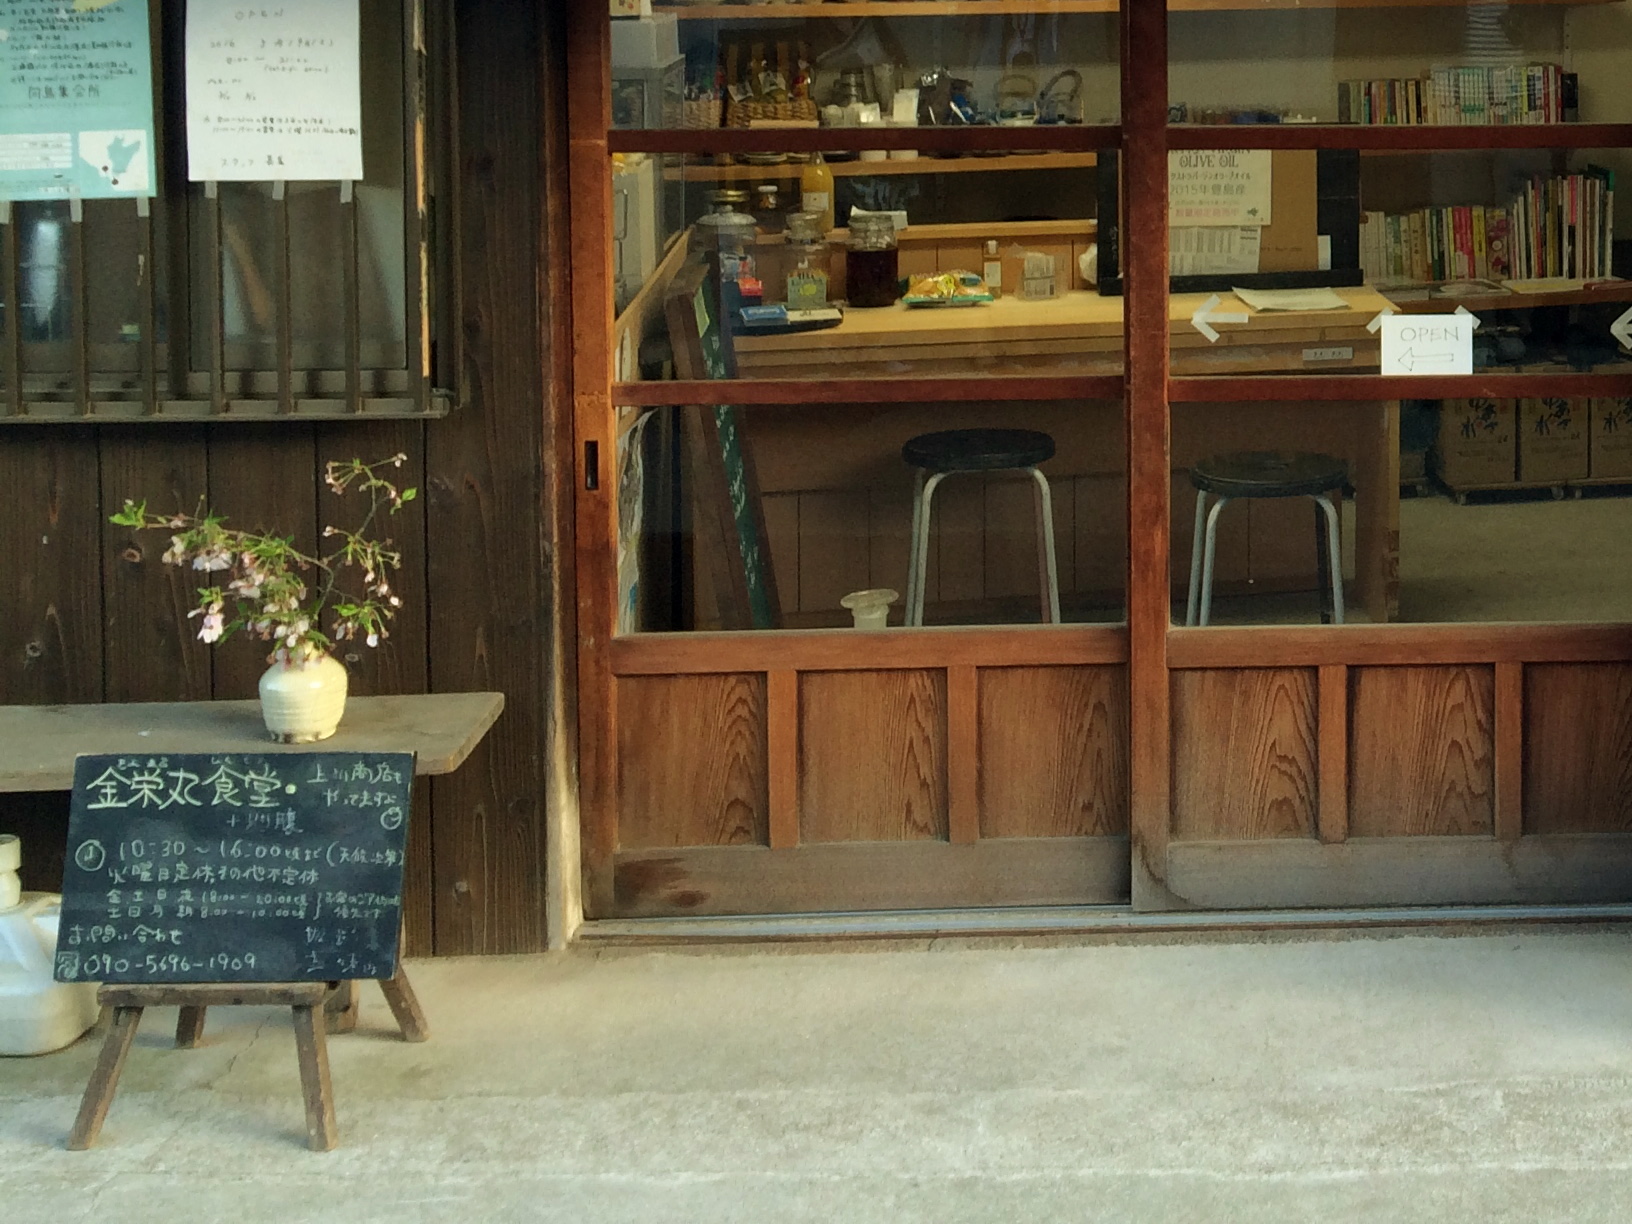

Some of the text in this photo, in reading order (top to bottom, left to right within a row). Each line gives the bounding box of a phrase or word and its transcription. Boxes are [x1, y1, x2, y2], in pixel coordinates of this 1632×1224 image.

[1179, 154, 1240, 168] OLIVE OIL
[1399, 326, 1460, 343] OPEN
[85, 765, 283, 811] 金栄丸食堂
